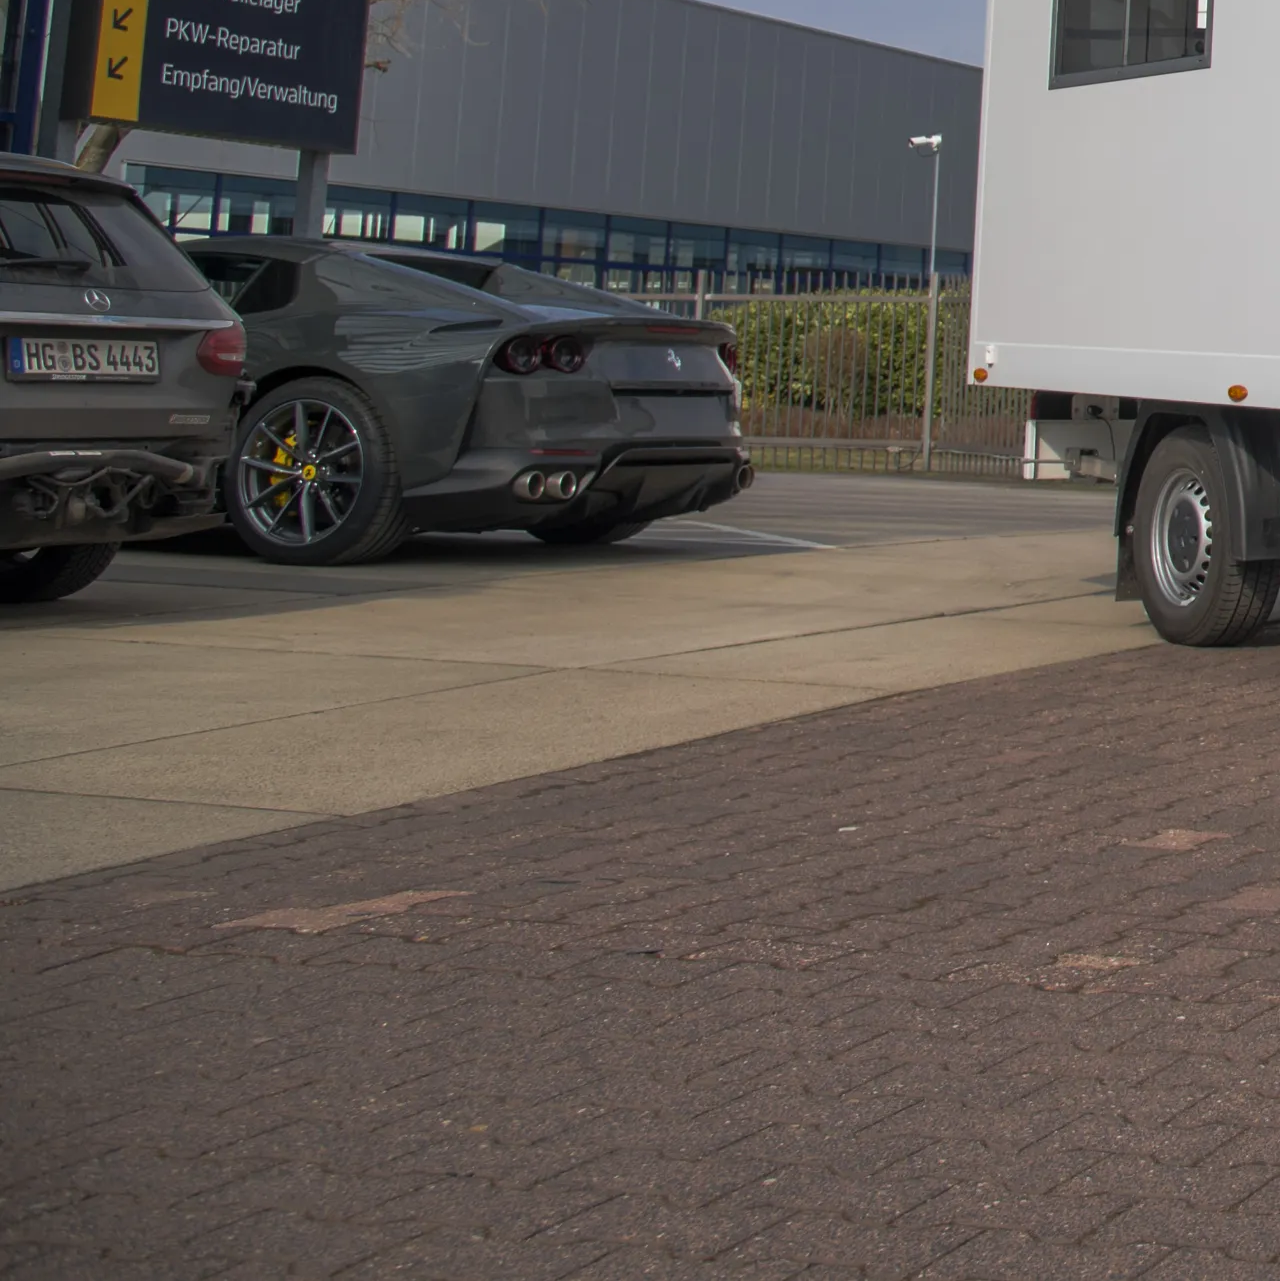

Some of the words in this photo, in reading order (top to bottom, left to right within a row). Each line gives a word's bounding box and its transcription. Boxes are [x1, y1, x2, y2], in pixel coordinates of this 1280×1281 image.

[166, 19, 300, 61] PKW-Reparatur
[161, 64, 338, 114] Empfang/Verwaltung
[26, 342, 56, 370] HG
[72, 344, 100, 371] BS
[107, 344, 156, 373] 4443
